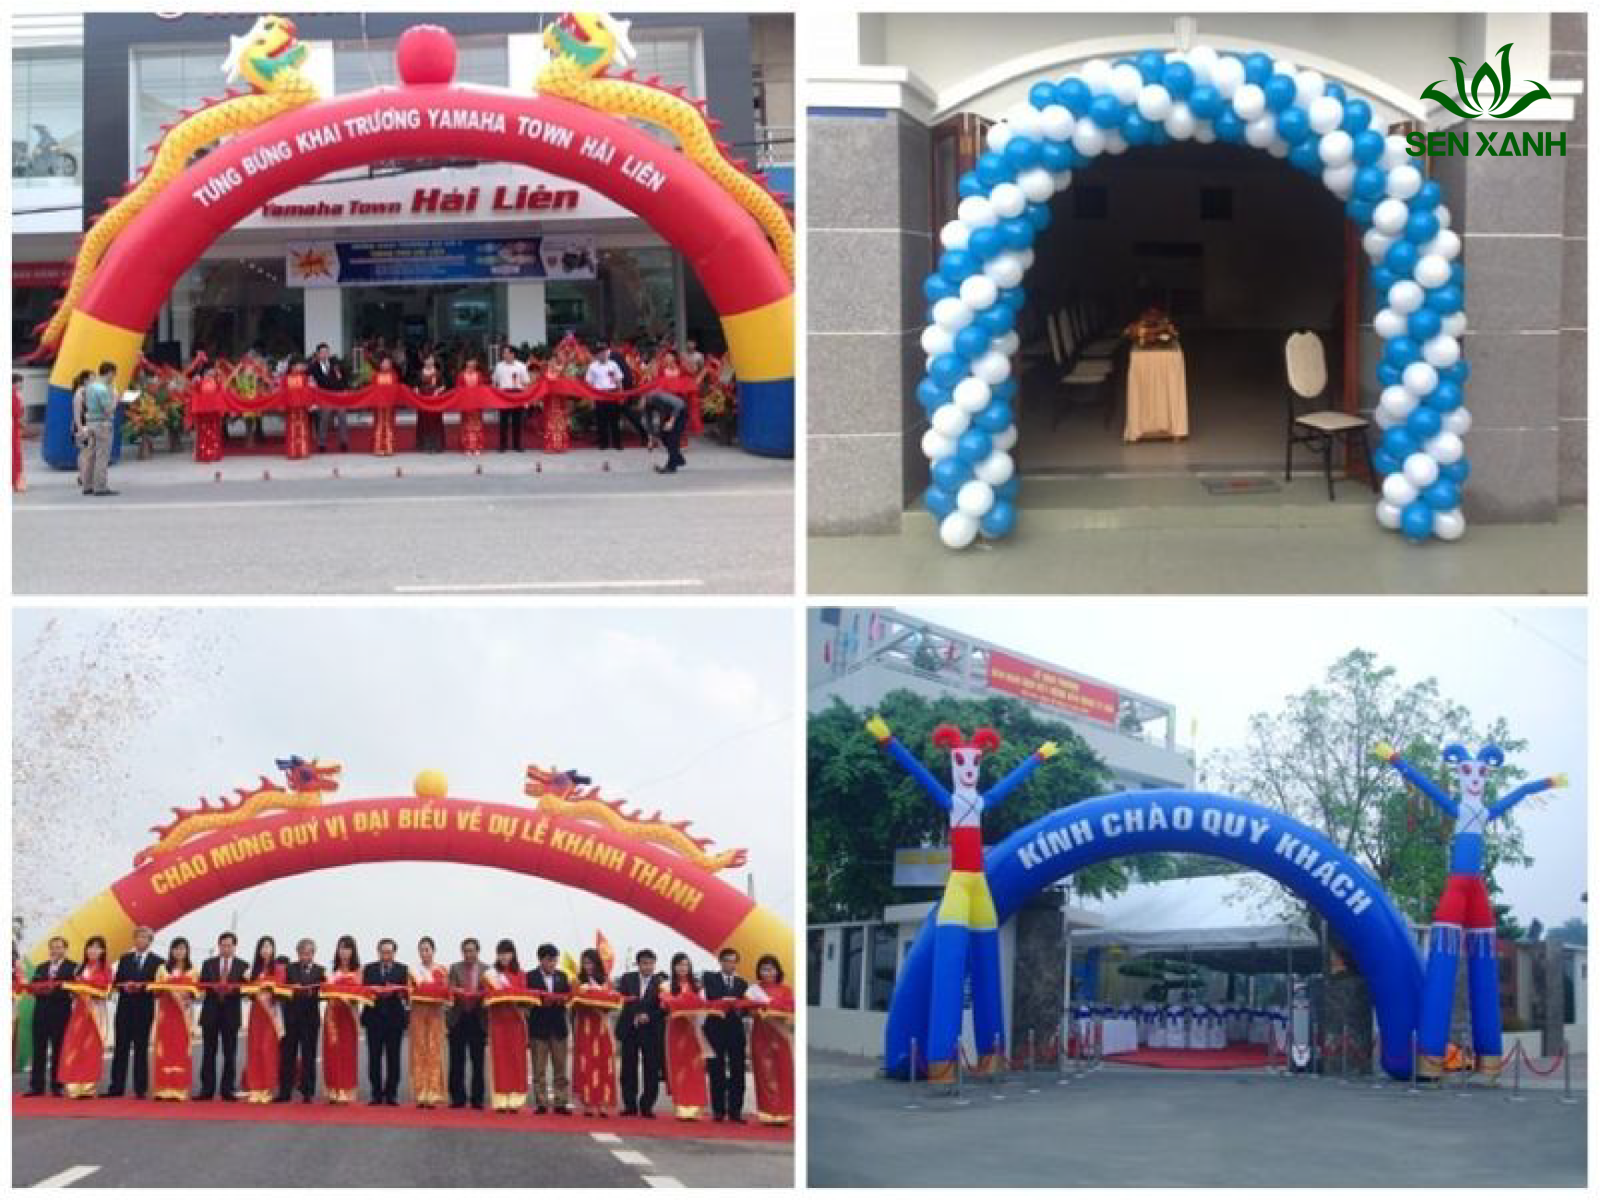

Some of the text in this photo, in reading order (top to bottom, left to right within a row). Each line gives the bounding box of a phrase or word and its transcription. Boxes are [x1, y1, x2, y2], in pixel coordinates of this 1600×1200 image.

[296, 123, 342, 154] KHAI
[427, 107, 506, 133] YAMAHA
[517, 114, 574, 149] TOWN
[620, 154, 667, 192] LIÊN
[261, 200, 344, 217] Yamaha
[350, 200, 402, 215] Town
[151, 854, 209, 894] CHÀO
[279, 818, 319, 849] QUÝ
[324, 814, 348, 840] VỊ
[353, 808, 389, 837] ĐẠI
[550, 827, 627, 872] KHÁNH
[629, 855, 705, 913] THÀNH
[1016, 801, 1374, 916] KÍNH CHÀO QUÝ KHÁCH
